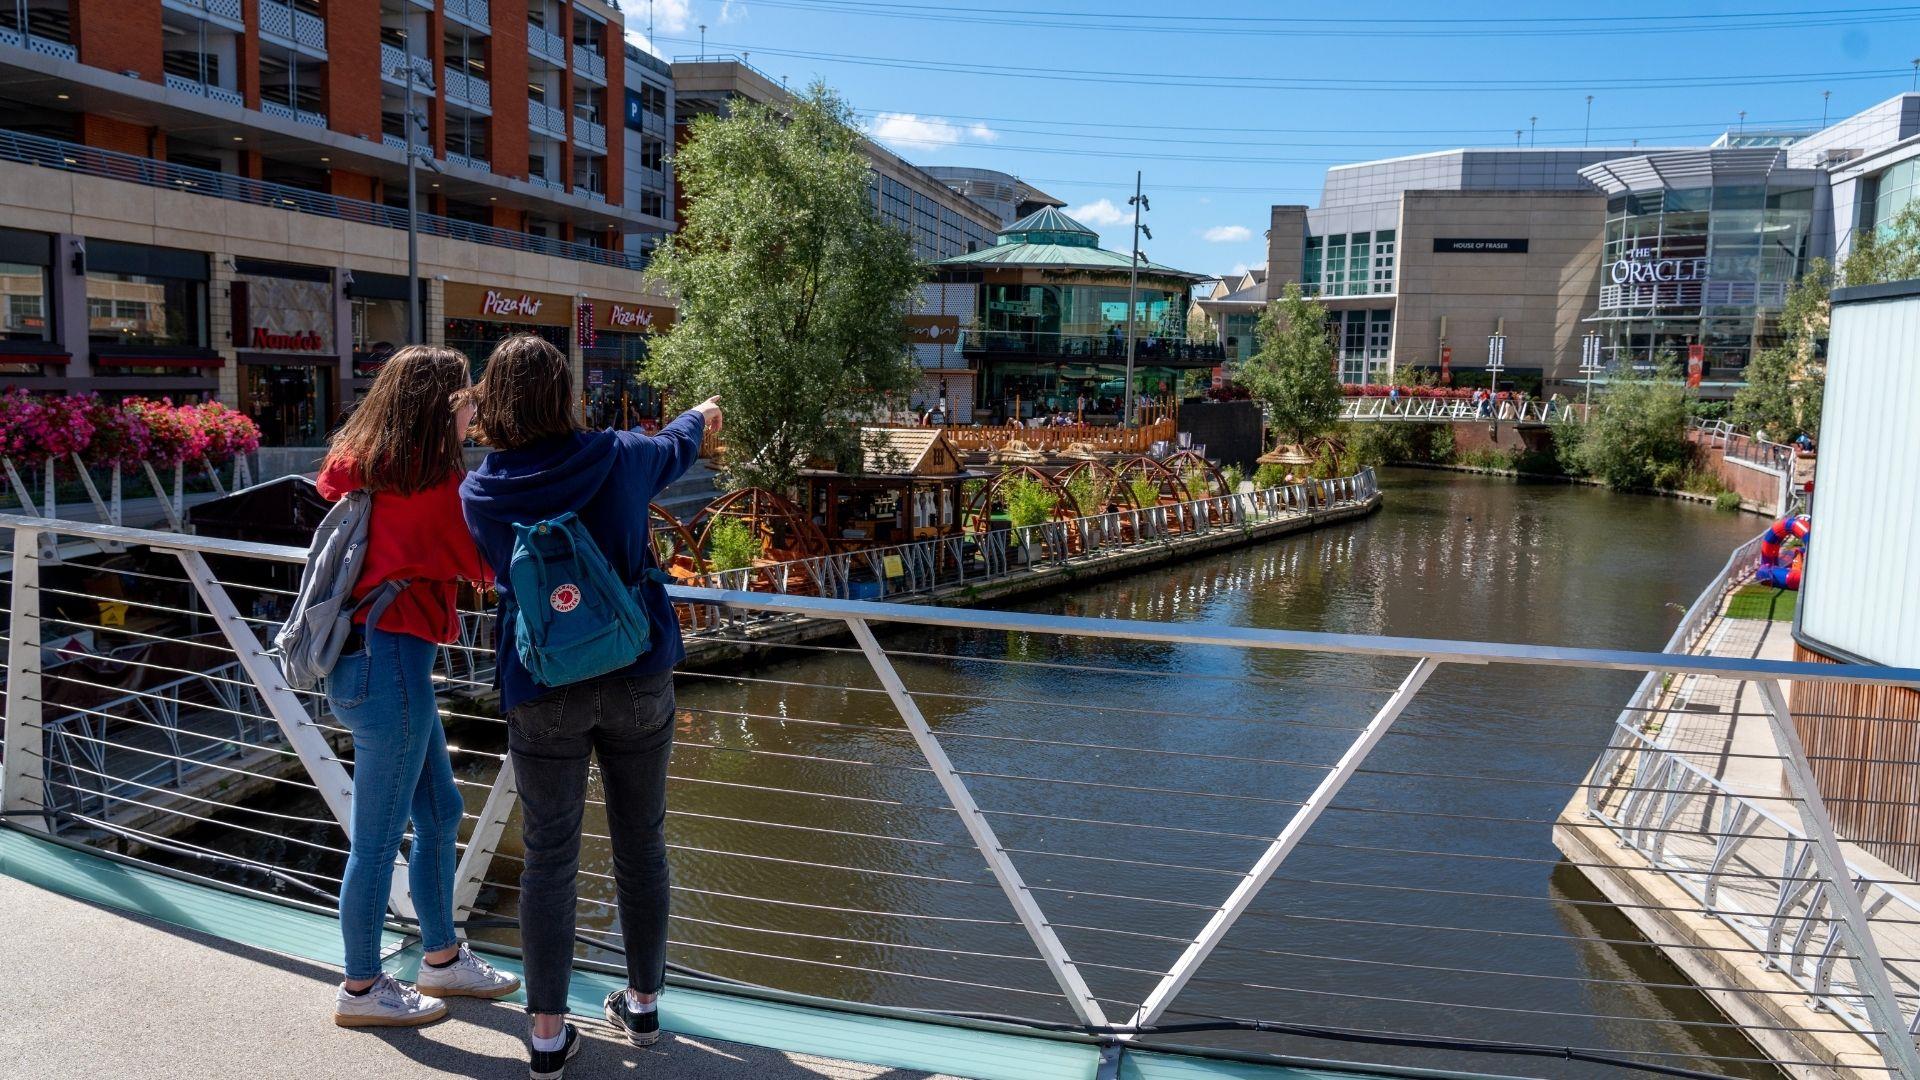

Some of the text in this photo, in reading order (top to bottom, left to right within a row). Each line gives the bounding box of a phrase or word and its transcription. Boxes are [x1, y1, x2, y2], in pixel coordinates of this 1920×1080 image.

[631, 102, 638, 118] P
[1627, 248, 1650, 258] THE
[1611, 259, 1710, 283] ORACLE
[483, 290, 543, 316] Pizza Hut
[611, 304, 654, 326] Pizza Hut
[253, 327, 322, 351] Nando's
[912, 325, 956, 338] moni
